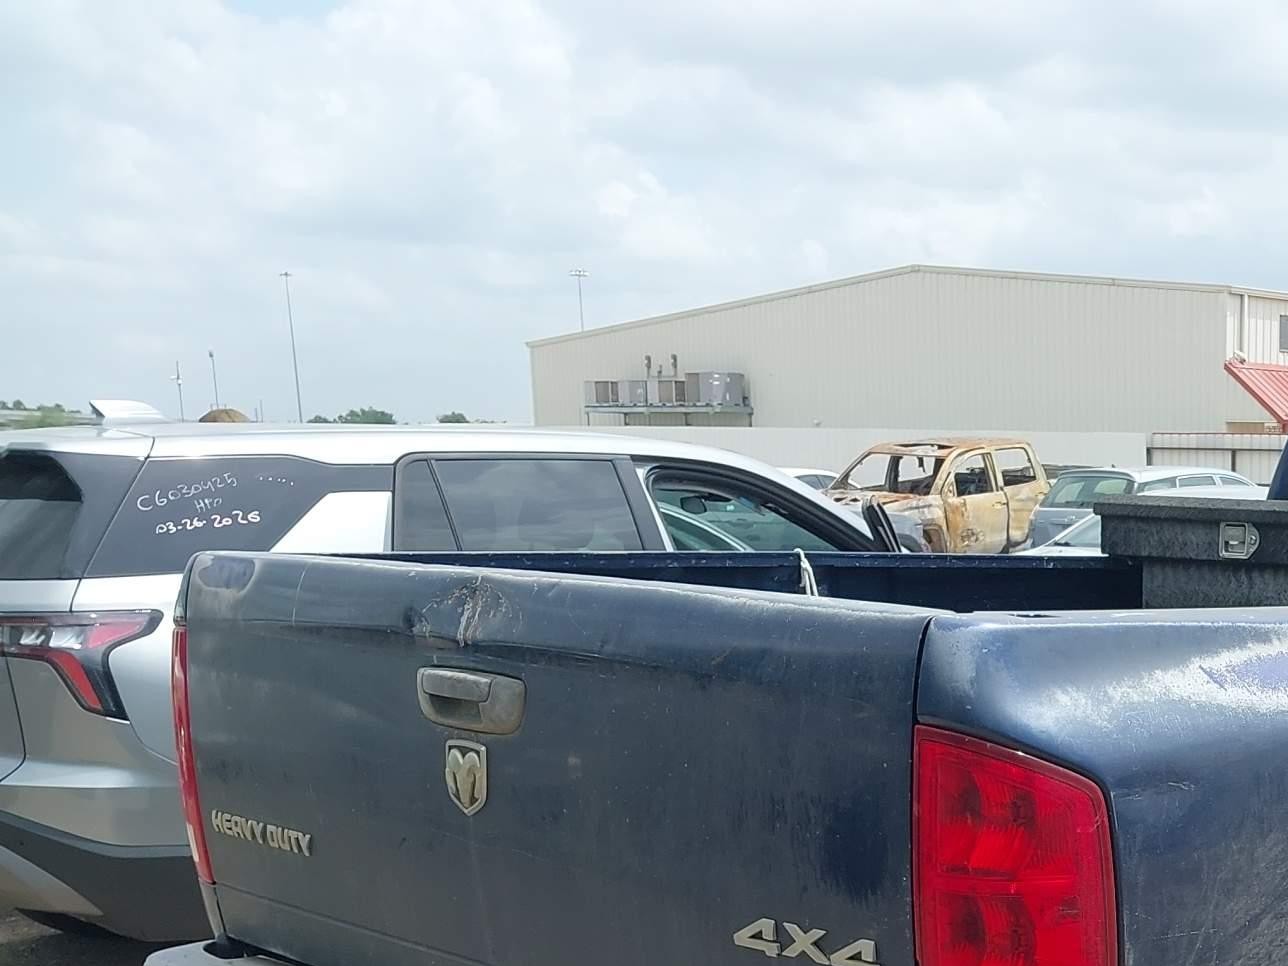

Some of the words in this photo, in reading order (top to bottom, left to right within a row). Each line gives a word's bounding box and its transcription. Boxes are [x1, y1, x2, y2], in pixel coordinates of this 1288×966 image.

[137, 472, 238, 511] C6030425
[212, 809, 264, 844] HEAVY
[266, 824, 311, 856] DUTY
